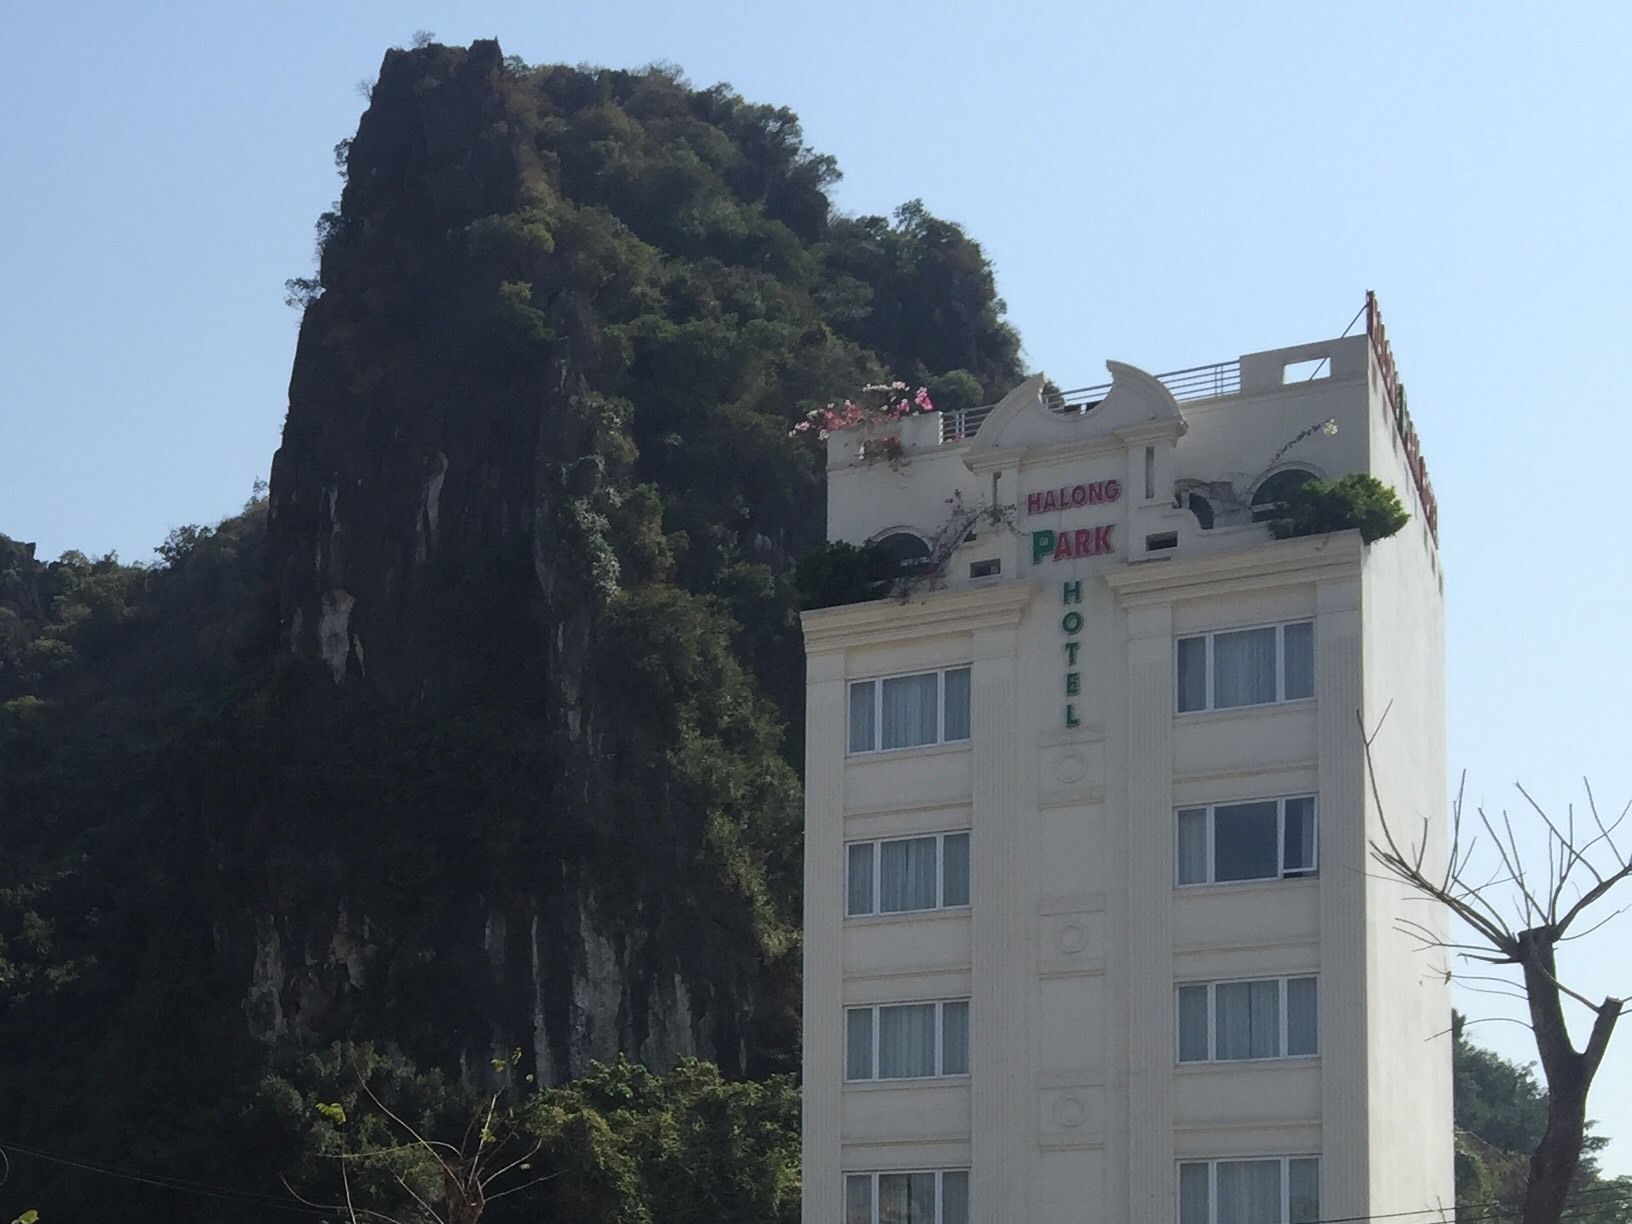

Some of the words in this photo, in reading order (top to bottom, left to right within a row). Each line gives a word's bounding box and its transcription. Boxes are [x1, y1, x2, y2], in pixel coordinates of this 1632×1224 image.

[1027, 479, 1120, 516] HALONG
[1032, 524, 1116, 565] PARK
[1063, 580, 1083, 728] HOTEL
